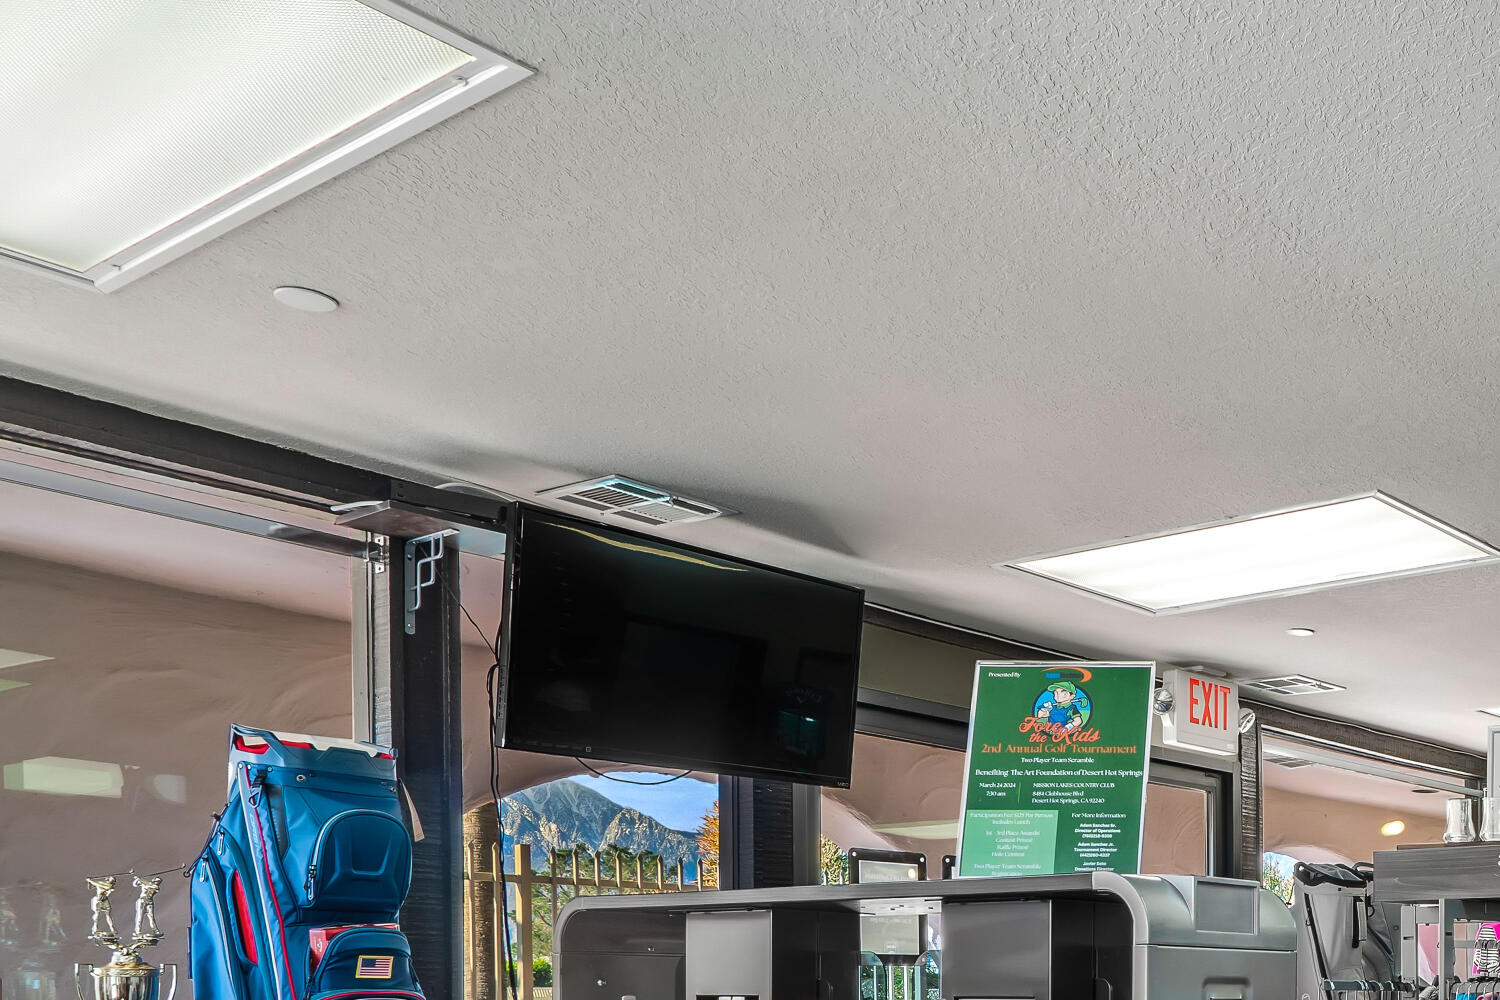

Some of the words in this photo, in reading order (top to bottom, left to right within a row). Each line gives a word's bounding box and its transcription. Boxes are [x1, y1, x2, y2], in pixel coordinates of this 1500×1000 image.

[1189, 678, 1231, 730] EXIT
[1018, 717, 1060, 733] Fore
[1028, 733, 1047, 743] the
[1052, 728, 1101, 745] Kids
[981, 743, 1002, 753] 2nd
[1005, 743, 1043, 753] Annual
[1044, 743, 1068, 753] Golf
[1070, 744, 1137, 754] Tournament
[1118, 769, 1143, 777] Springs
